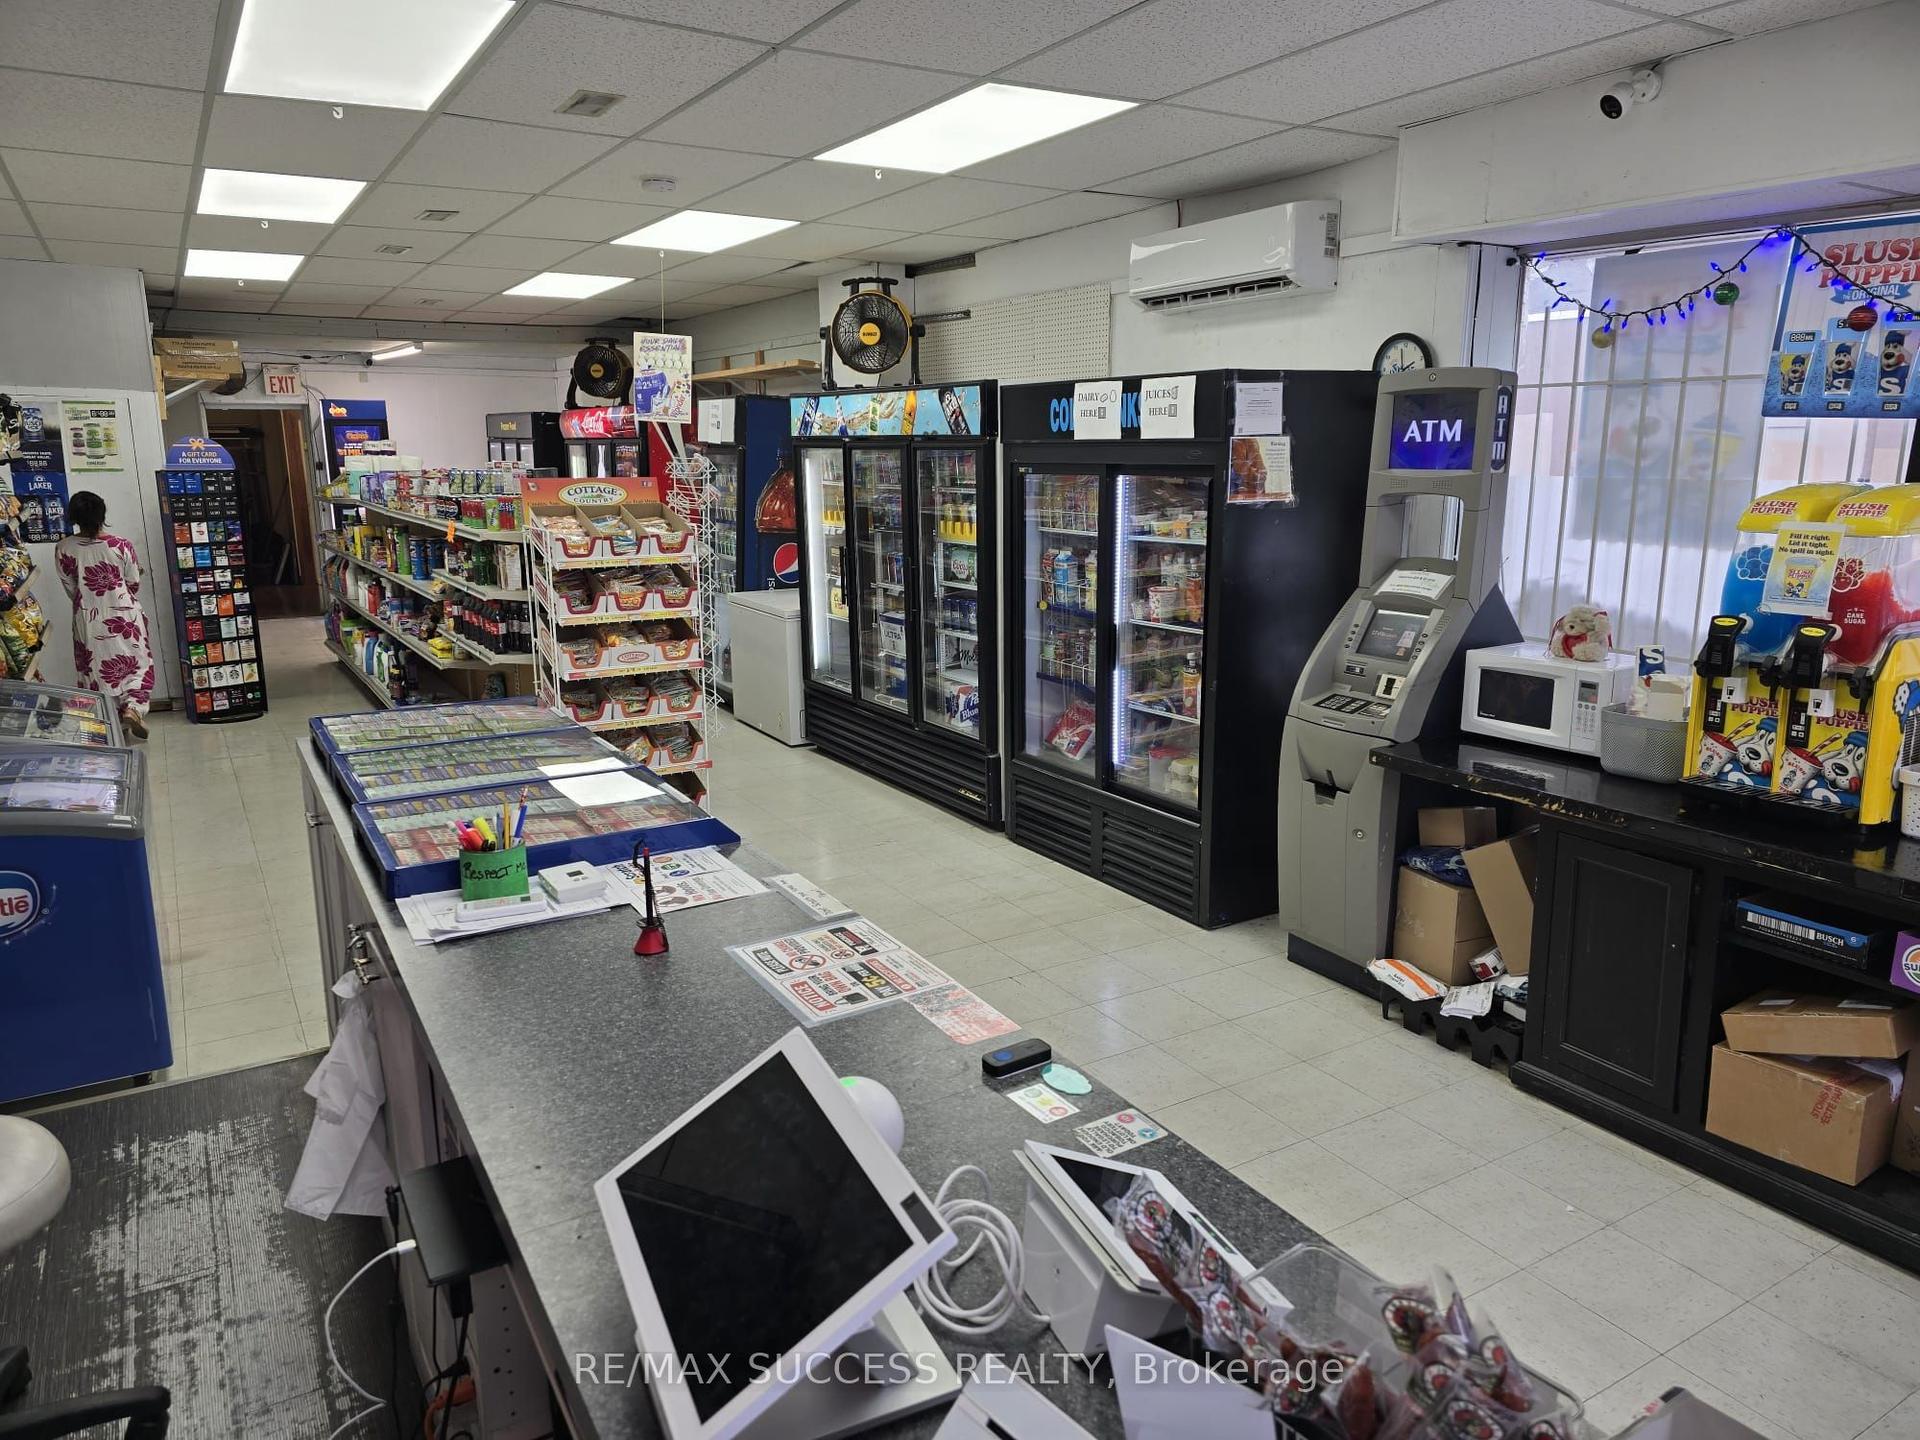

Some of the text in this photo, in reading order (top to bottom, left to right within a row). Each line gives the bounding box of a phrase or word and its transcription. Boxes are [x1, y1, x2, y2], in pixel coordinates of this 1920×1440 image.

[1851, 286, 1901, 300] ORIGINAL
[269, 375, 296, 394] EXIT
[1077, 392, 1100, 402] DAIRY
[1145, 389, 1172, 400] JUICES
[1080, 408, 1098, 419] HERE
[1148, 406, 1168, 417] HERE
[1403, 419, 1463, 443] ATM
[1492, 395, 1508, 460] ATM
[28, 482, 52, 490] LAKER
[567, 486, 618, 496] COTTAGE
[574, 496, 614, 504] COUNTRY
[1753, 500, 1798, 508] SLUSH
[1750, 506, 1796, 515] PUPPIE
[1840, 503, 1889, 511] SLUSH
[1837, 509, 1887, 518] PUPPIE
[1790, 547, 1805, 555] spill
[1815, 549, 1835, 557] sight.
[884, 630, 902, 641] ULTRA
[1752, 697, 1779, 709] USH
[1731, 703, 1779, 717] PUPPIE
[1836, 709, 1869, 722] USH
[1816, 716, 1869, 730] PUPPIE
[0, 895, 29, 916] tlé
[1816, 932, 1844, 947] BUSCH
[791, 983, 830, 1008] NOTICE
[872, 984, 899, 997] PAY
